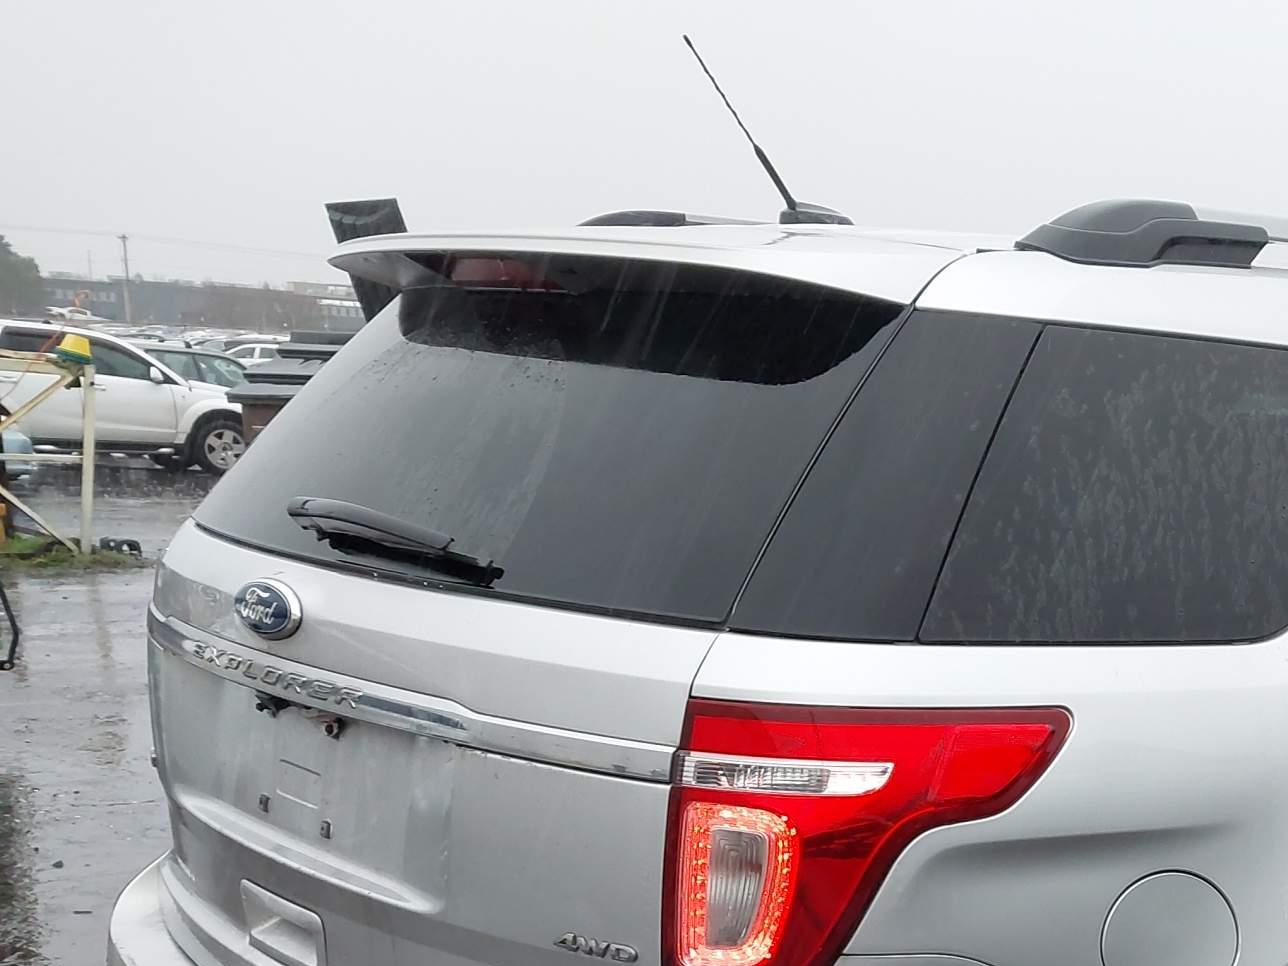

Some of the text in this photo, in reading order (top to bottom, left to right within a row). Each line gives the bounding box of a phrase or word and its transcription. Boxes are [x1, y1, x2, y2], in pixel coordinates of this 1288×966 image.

[237, 587, 279, 625] Ford
[191, 640, 363, 709] EXPLORER
[553, 932, 639, 963] 4WD
